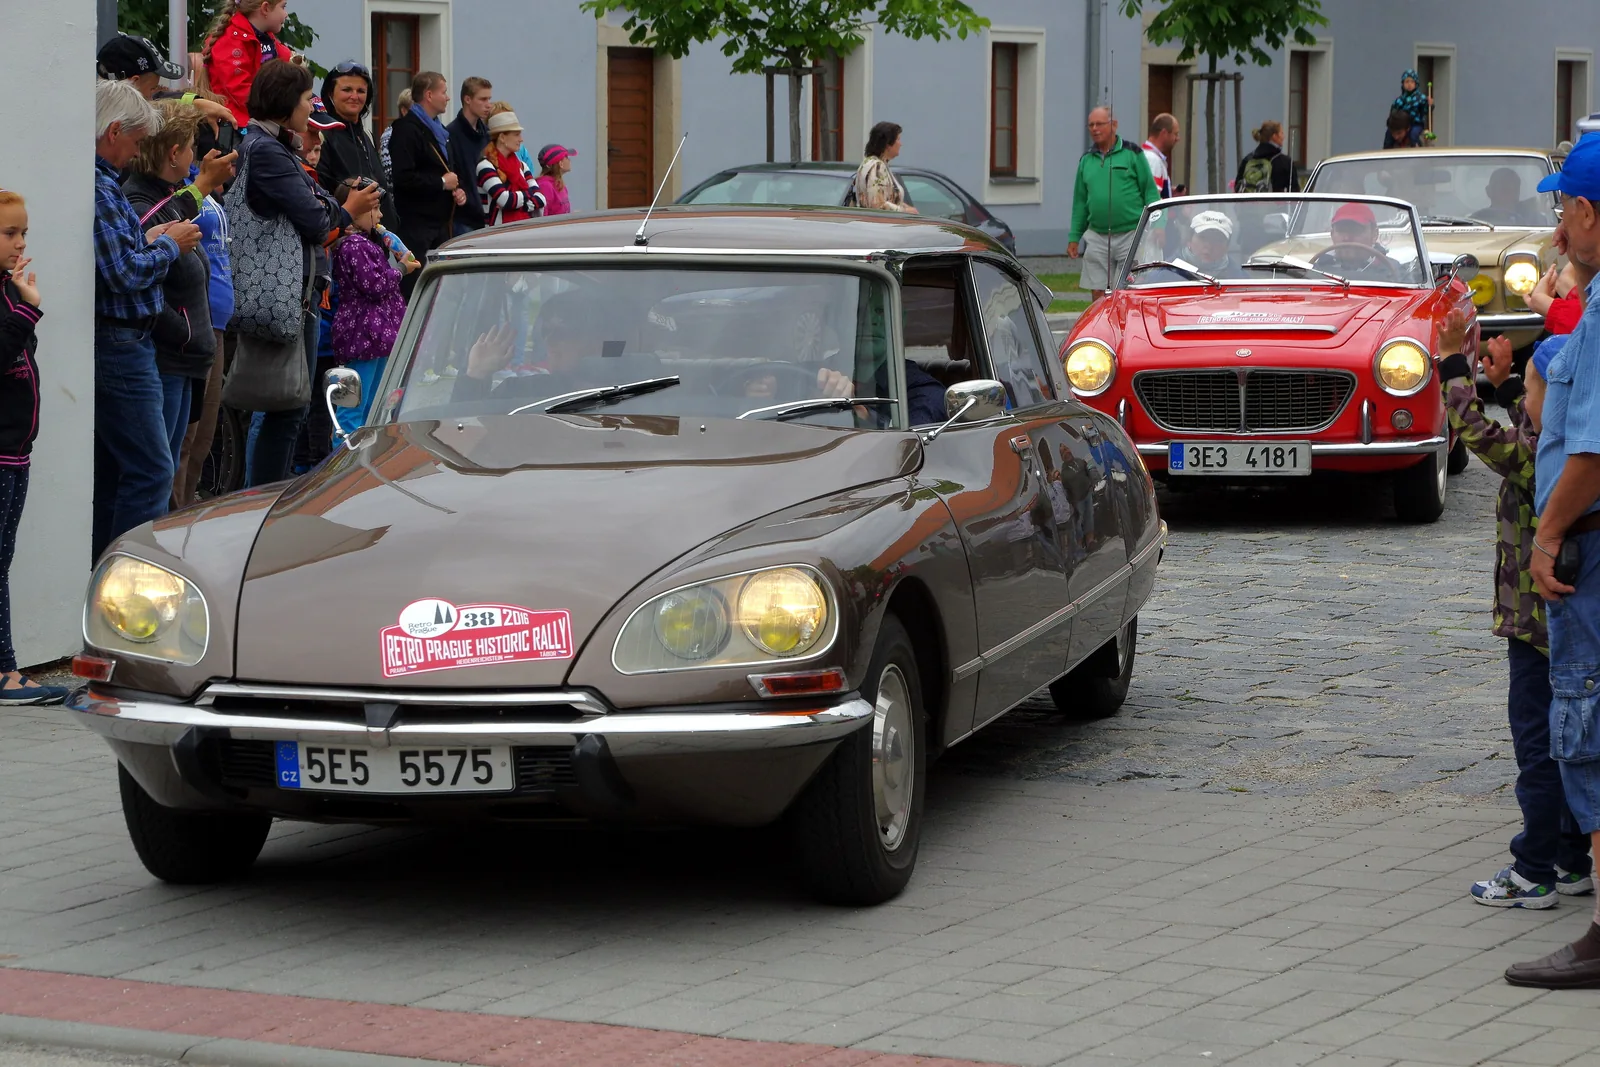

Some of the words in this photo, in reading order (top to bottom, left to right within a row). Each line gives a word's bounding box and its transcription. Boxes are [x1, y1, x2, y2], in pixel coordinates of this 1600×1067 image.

[1188, 447, 1228, 467] 3E3
[1245, 447, 1298, 467] 4181
[464, 612, 495, 628] 38
[502, 608, 529, 627] 2016
[386, 635, 424, 668] RETRO
[425, 639, 473, 662] PRAGUE
[476, 630, 529, 655] HISTORIC
[532, 616, 567, 651] RALLY
[281, 771, 298, 782] CZ
[306, 747, 370, 786] 5E5
[399, 749, 493, 787] 5575
